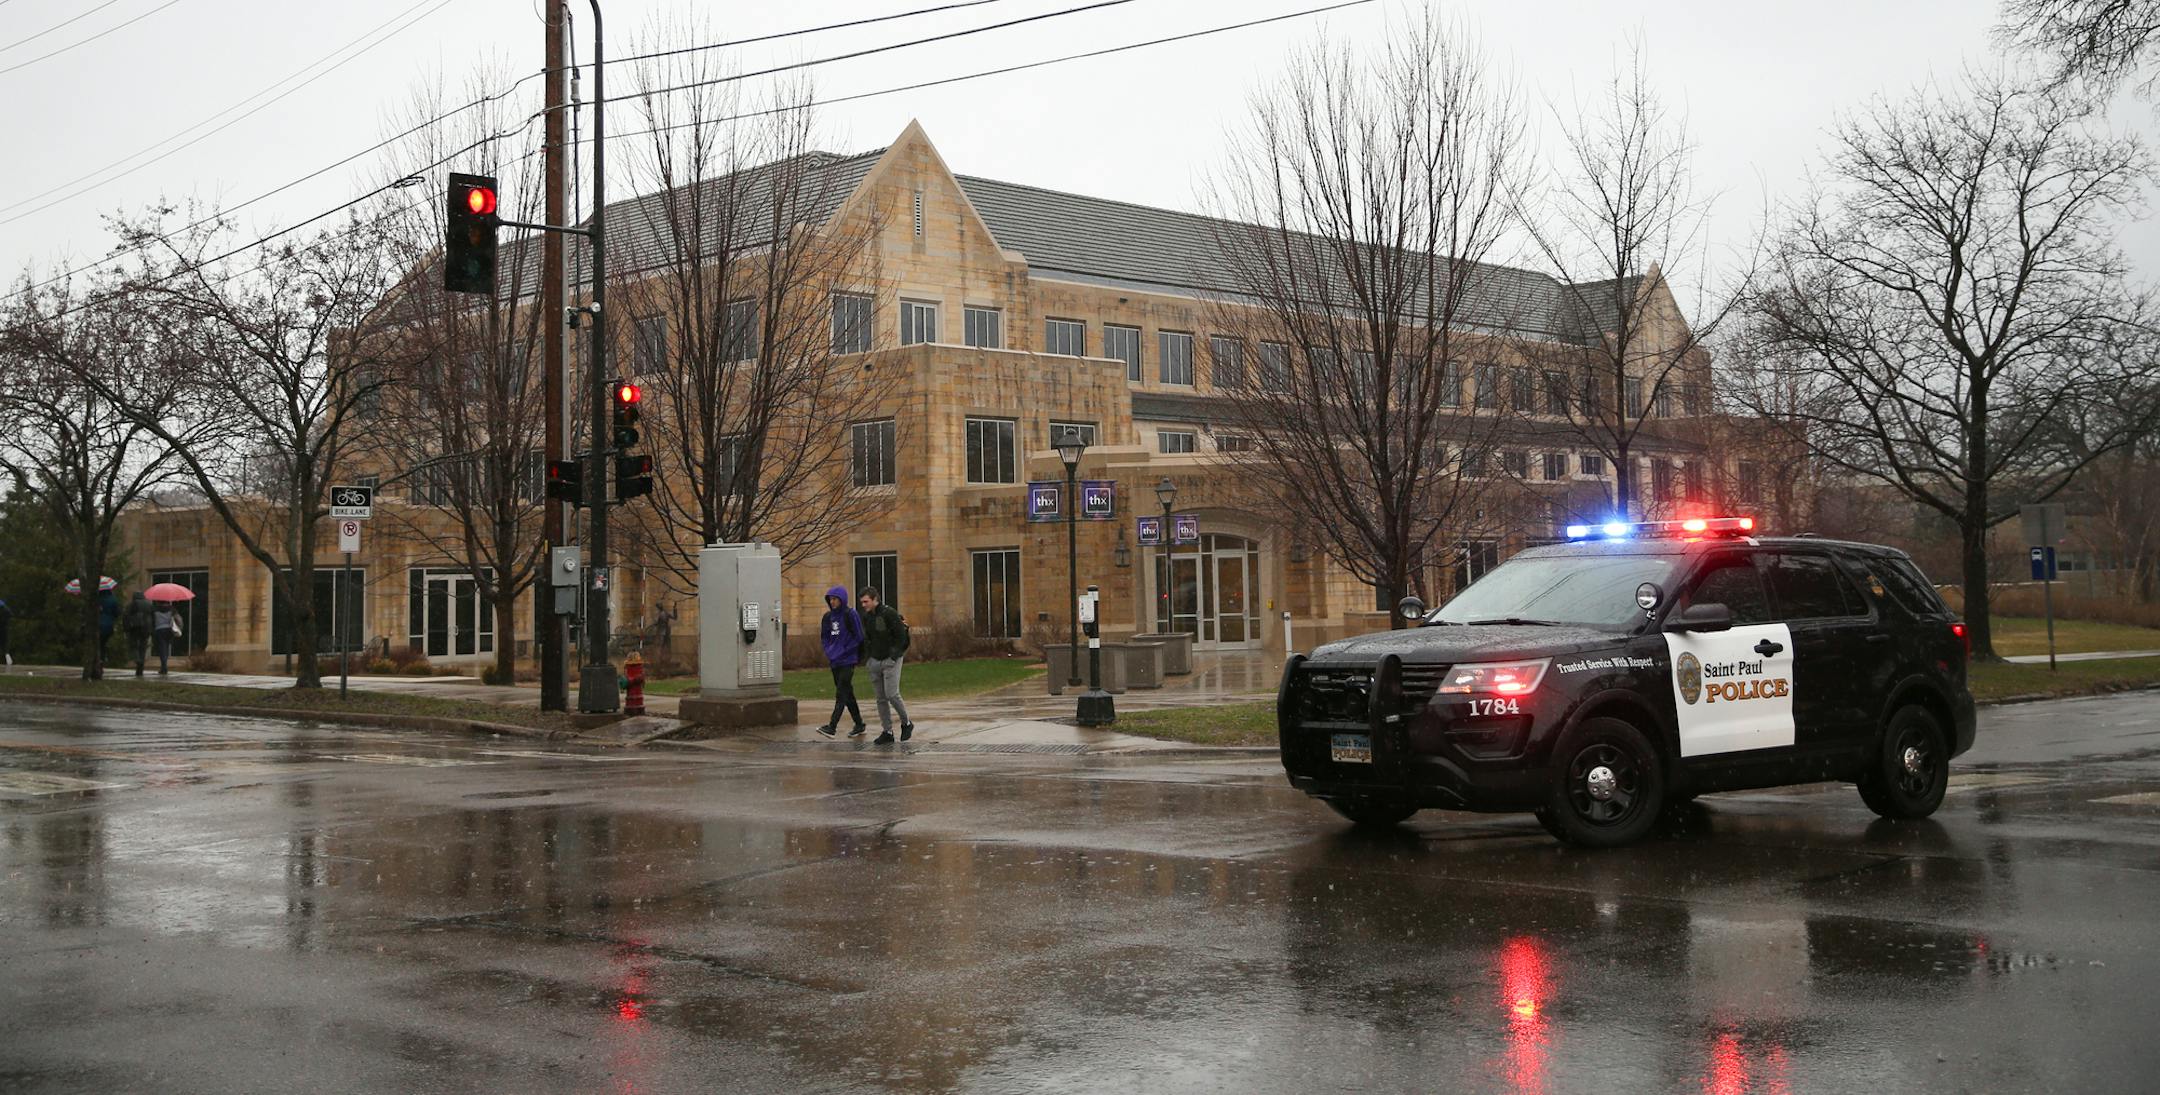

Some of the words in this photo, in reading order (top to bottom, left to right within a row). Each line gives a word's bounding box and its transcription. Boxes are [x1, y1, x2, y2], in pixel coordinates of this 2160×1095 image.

[1036, 494, 1055, 507] thx
[1088, 493, 1107, 506] thx
[1142, 526, 1157, 535] thx
[1180, 524, 1194, 534] thx
[1556, 660, 1588, 674] Trusted
[1585, 658, 1613, 670] Service
[1610, 656, 1630, 667] With
[1627, 656, 1654, 670] Respect
[1704, 661, 1735, 678] Saint
[1738, 659, 1763, 676] Paul
[1705, 678, 1789, 703] POLICE
[1469, 698, 1520, 716] 1784
